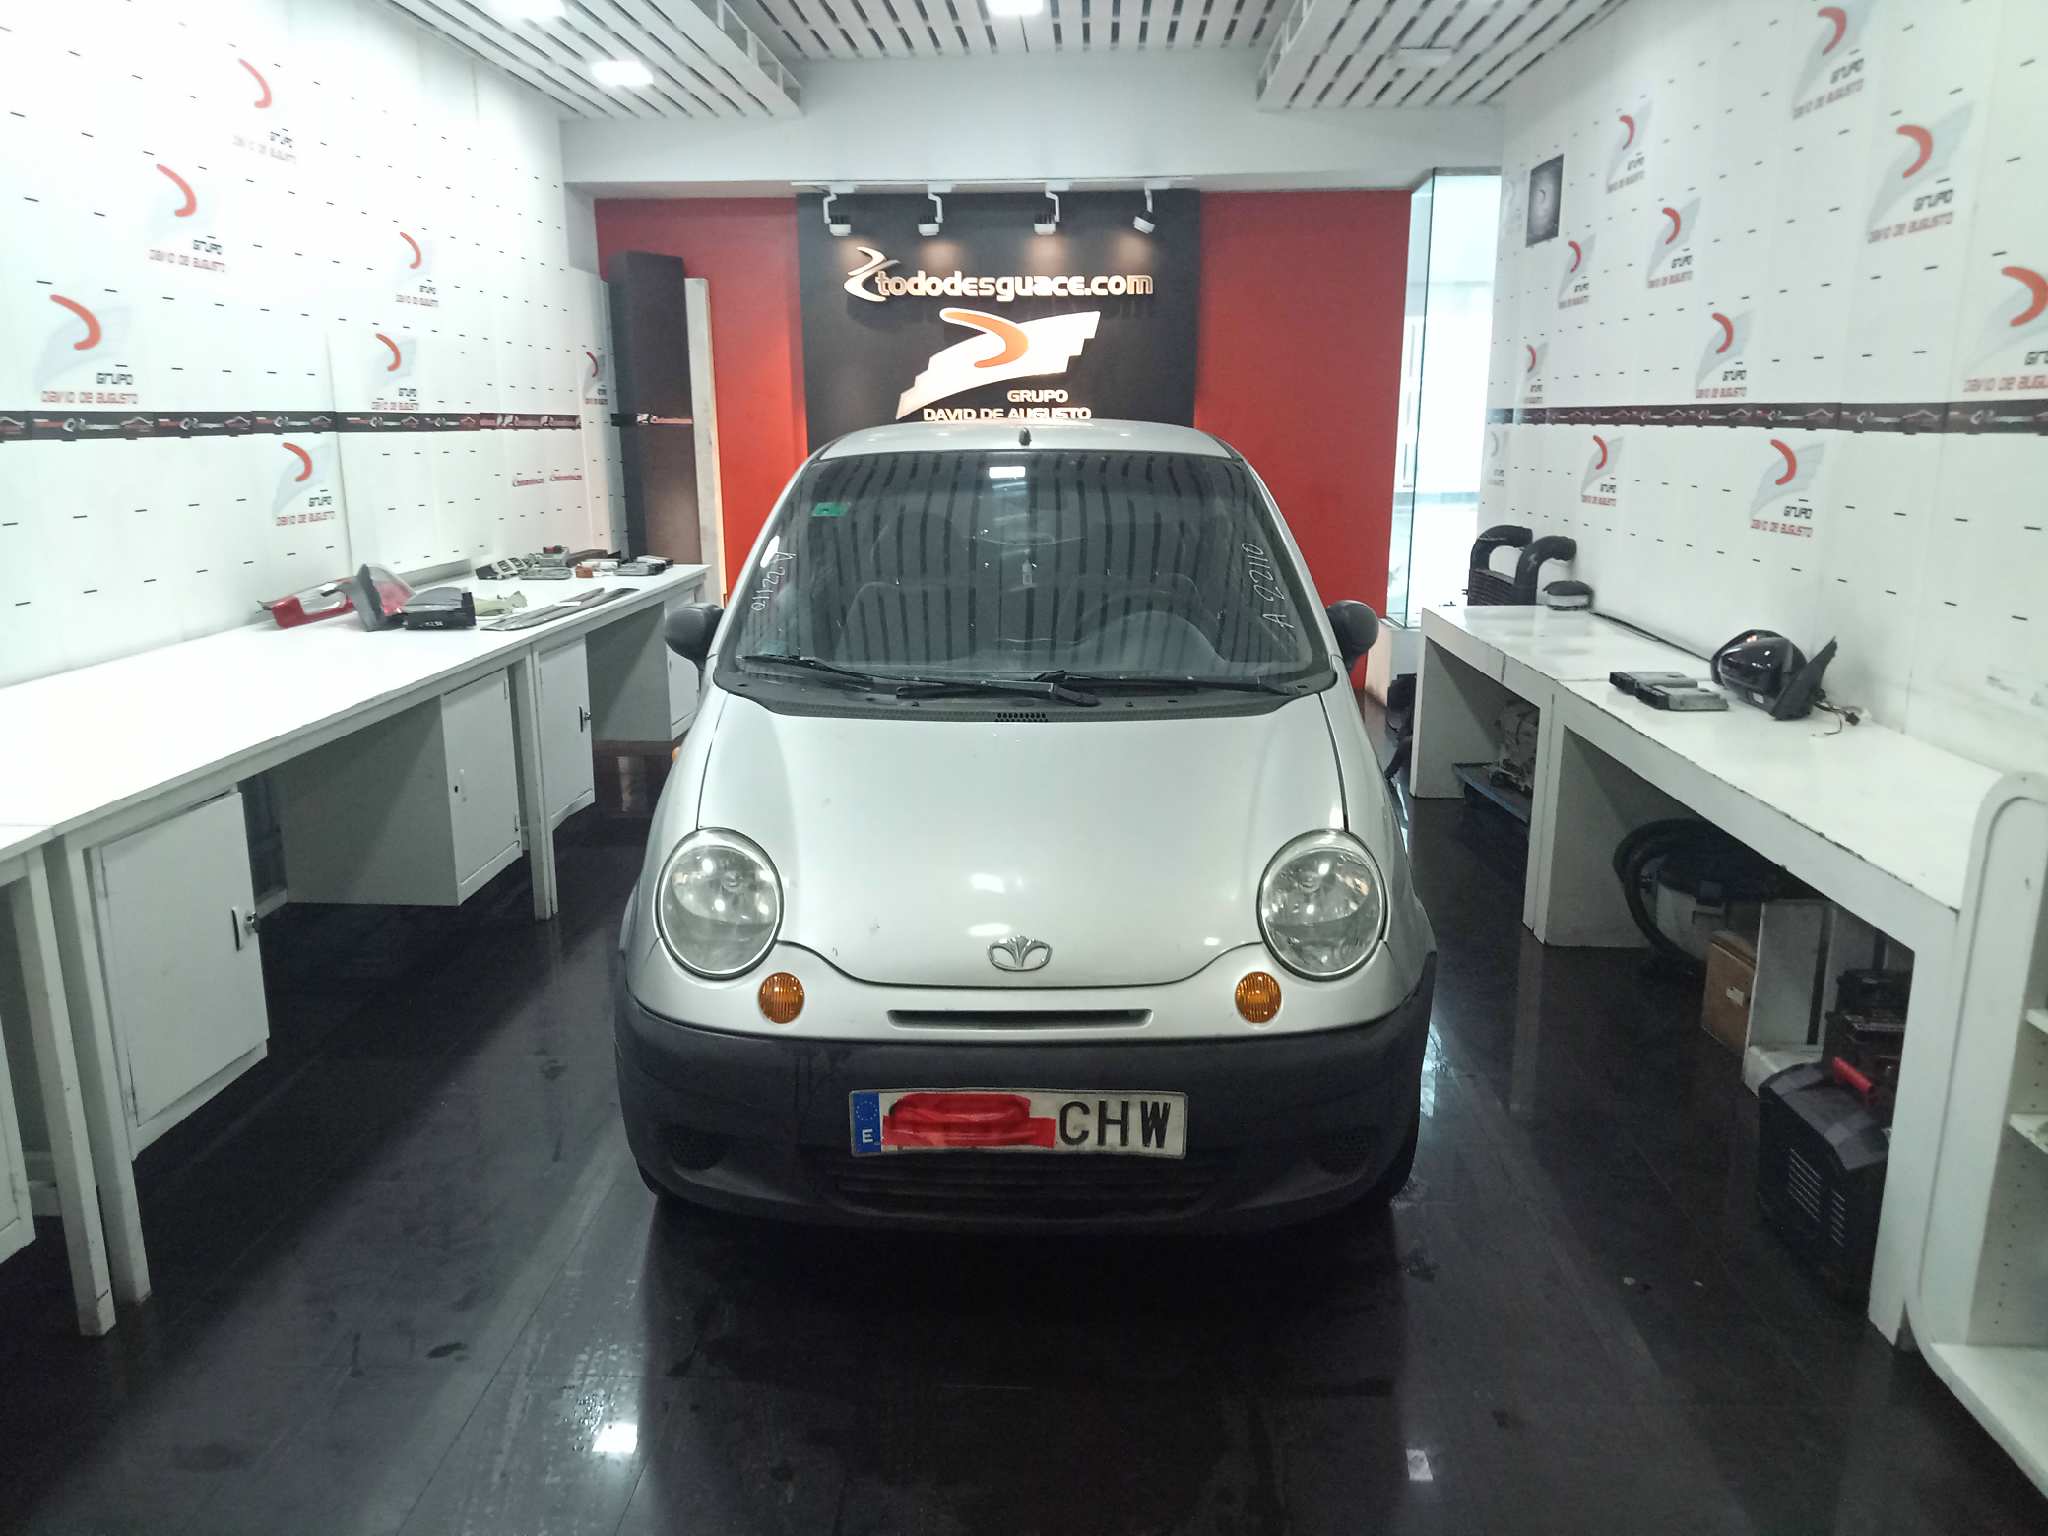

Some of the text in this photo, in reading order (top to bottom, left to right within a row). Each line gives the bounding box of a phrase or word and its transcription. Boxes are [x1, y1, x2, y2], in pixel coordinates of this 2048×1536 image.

[874, 270, 1154, 302] tododesguace.com
[1006, 388, 1070, 403] GRUPO
[923, 407, 1092, 422] DAVID DE AUGUSTO
[1242, 543, 1295, 629] A 22110
[861, 1100, 1172, 1148] E CHW
